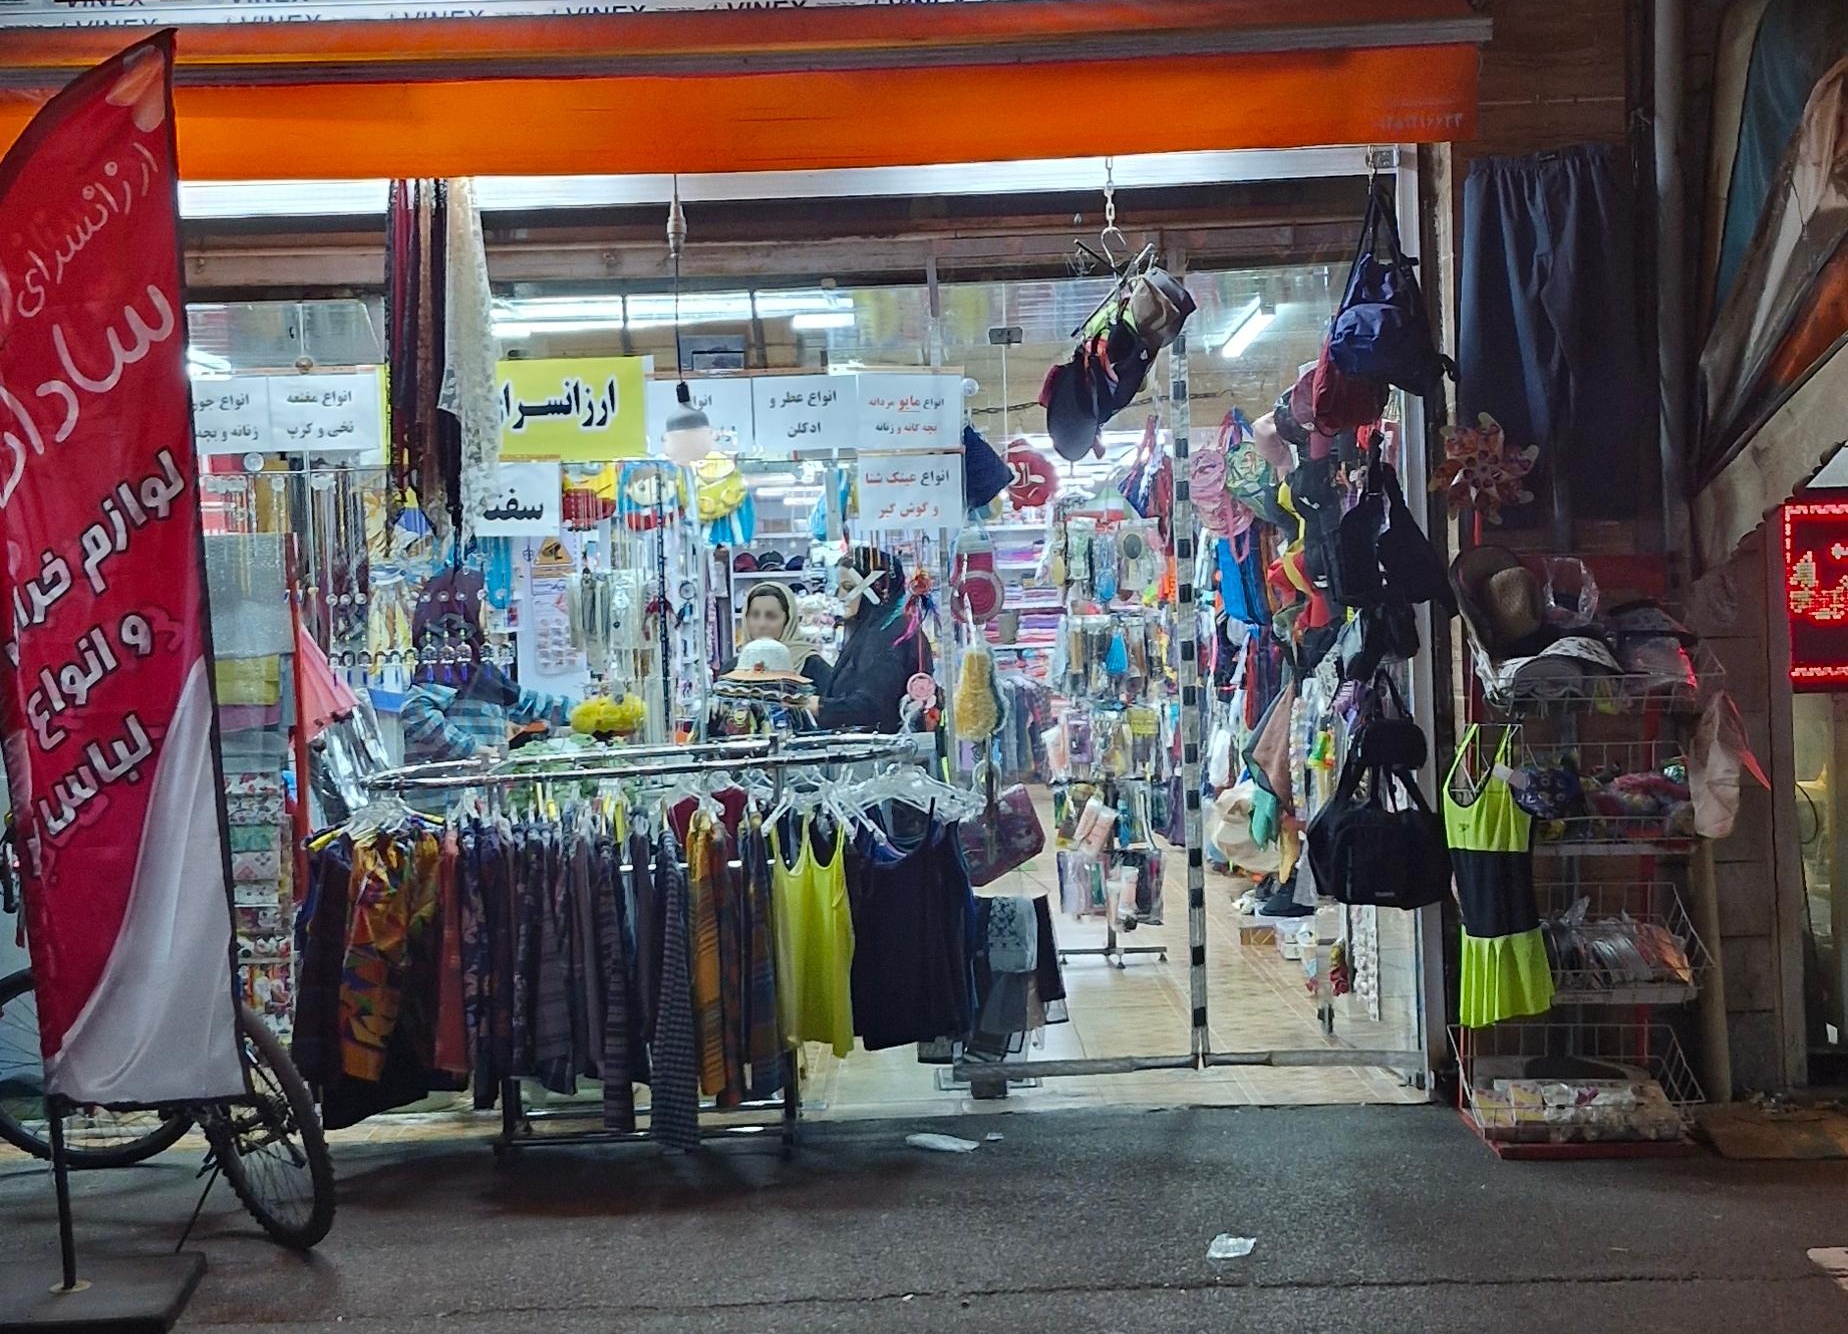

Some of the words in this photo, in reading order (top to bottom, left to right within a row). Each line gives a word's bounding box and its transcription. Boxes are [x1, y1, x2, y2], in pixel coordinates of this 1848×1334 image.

[17, 141, 159, 318] ارزانسرای
[219, 393, 250, 410] انواع
[322, 390, 352, 407] انواع
[693, 394, 712, 411] انوا
[769, 397, 776, 409] و
[780, 390, 803, 408] عطر
[807, 390, 837, 407] انواع
[898, 395, 921, 411] مایو
[923, 398, 944, 409] انواع
[317, 427, 324, 438] و
[787, 421, 821, 438] ادکلن
[886, 471, 916, 486] عینک
[921, 470, 950, 486] انواع
[932, 505, 939, 517] و
[80, 447, 186, 597] لوازم
[120, 611, 153, 657] و
[26, 626, 120, 754] انواع
